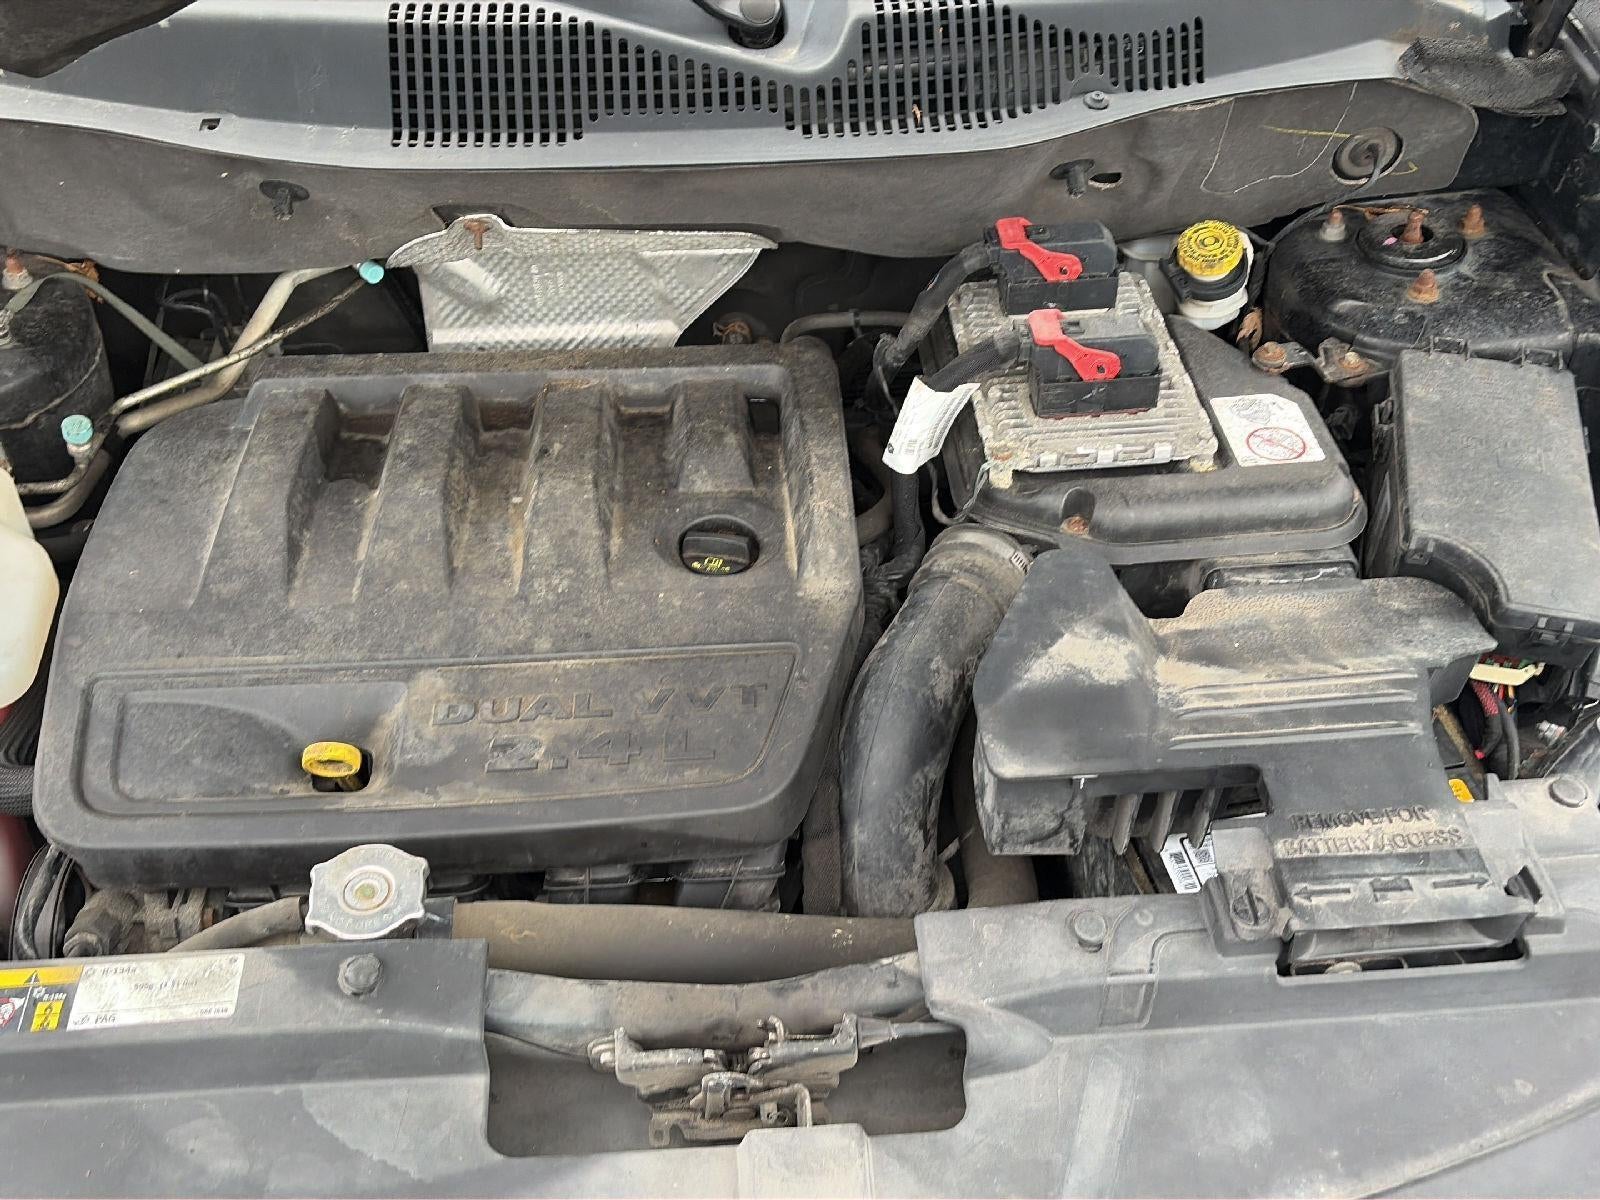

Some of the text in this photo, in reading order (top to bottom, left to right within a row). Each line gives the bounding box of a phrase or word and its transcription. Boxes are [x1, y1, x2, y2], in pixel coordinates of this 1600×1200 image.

[432, 683, 767, 726] DUAL VVT
[484, 729, 717, 774] 2.4L
[1290, 803, 1432, 830] REMOVE FOR
[1281, 826, 1463, 857] BATTERY ACCESS
